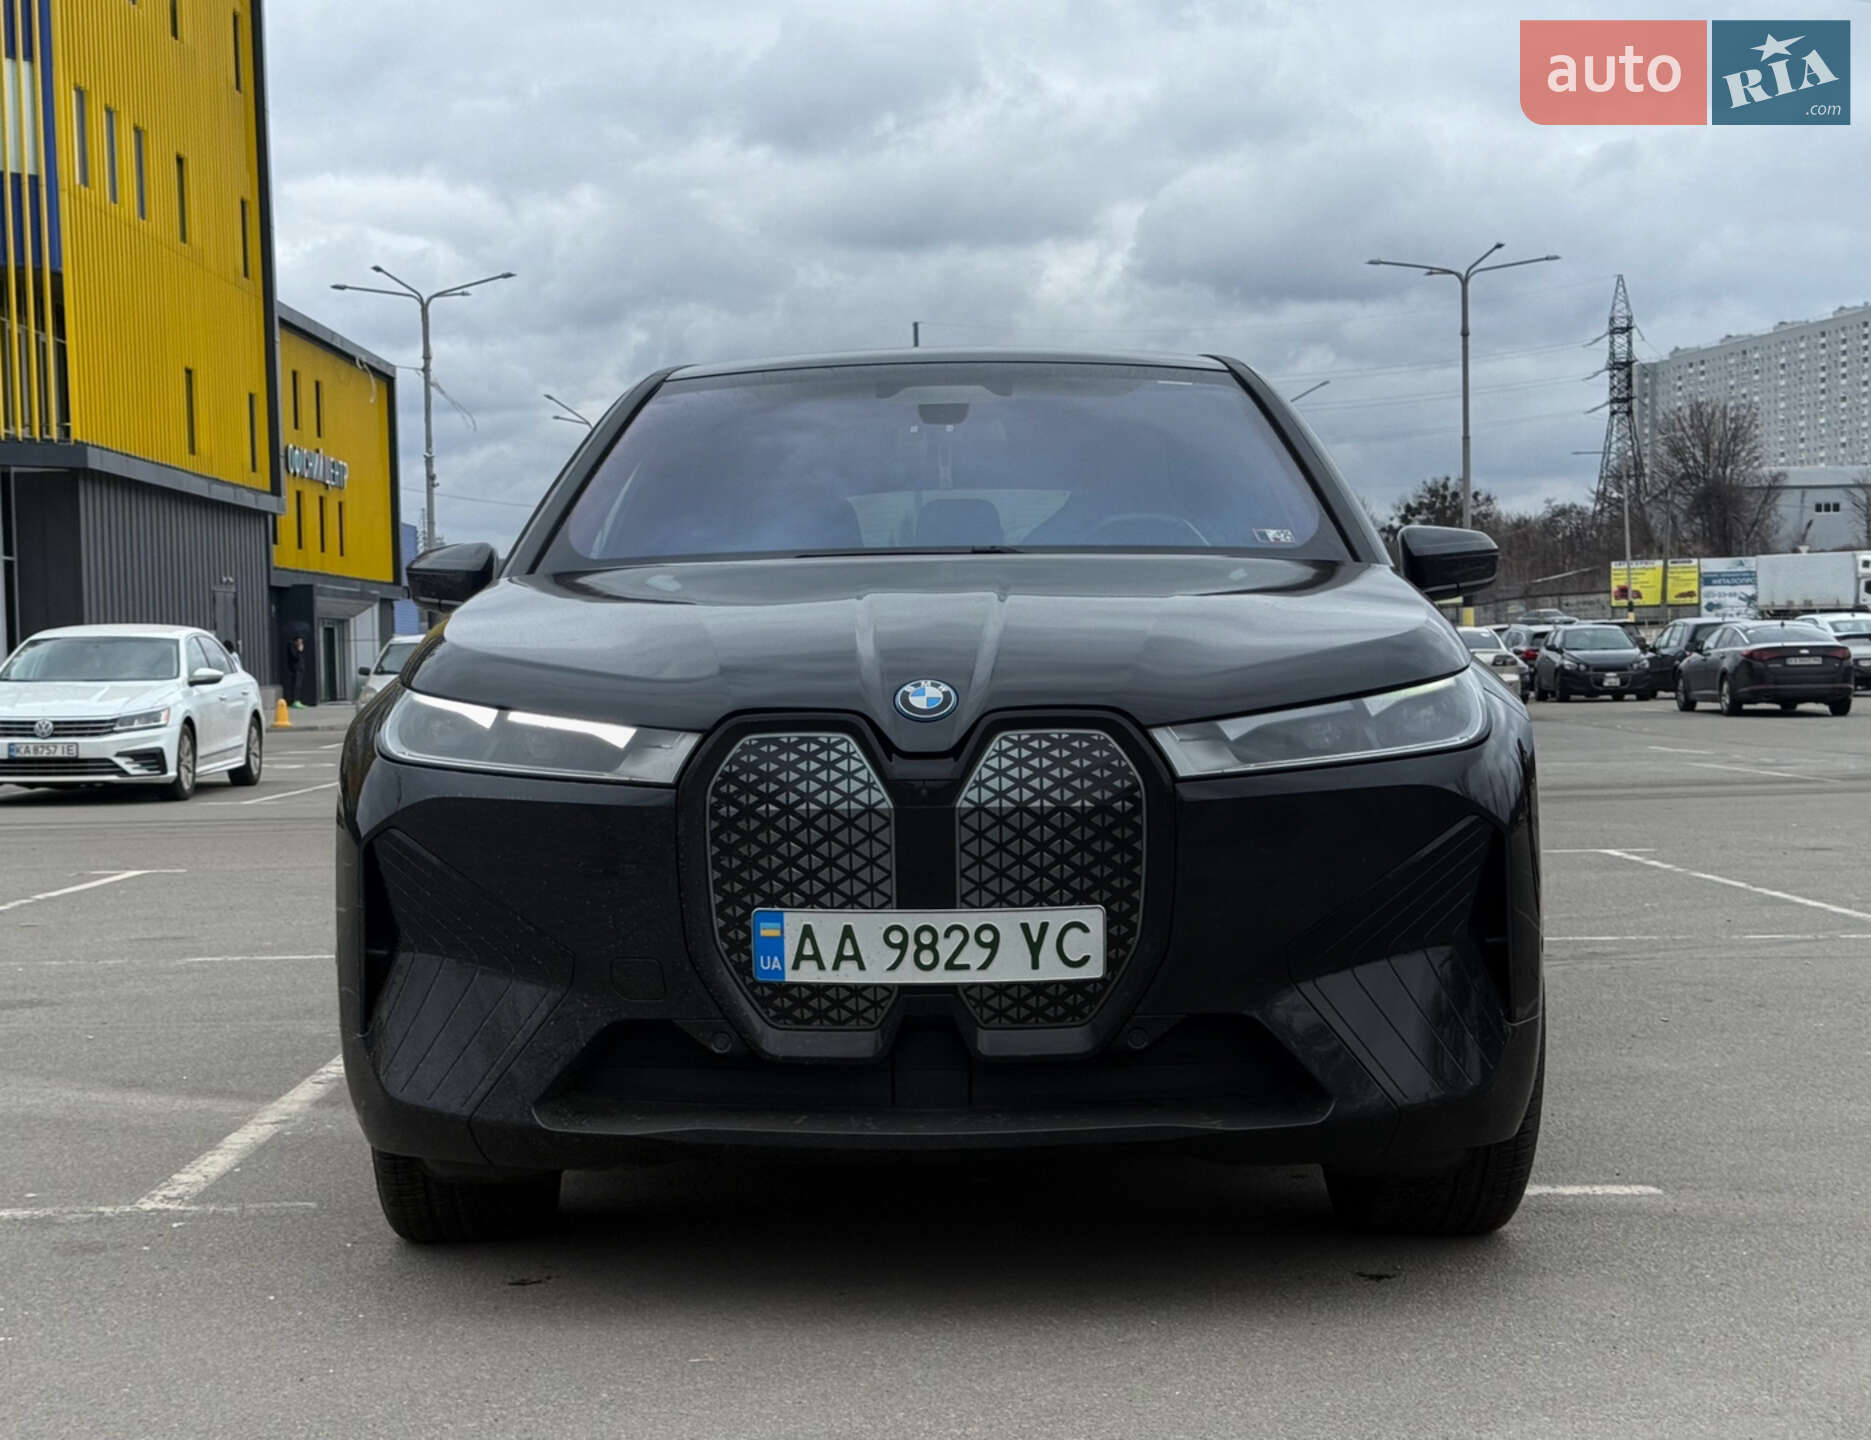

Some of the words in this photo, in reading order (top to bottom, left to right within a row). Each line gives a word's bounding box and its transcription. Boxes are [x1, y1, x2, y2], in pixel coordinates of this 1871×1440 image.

[791, 923, 867, 971] AA
[882, 923, 1001, 972] 9829
[1020, 920, 1092, 969] YC
[759, 956, 782, 971] UA
